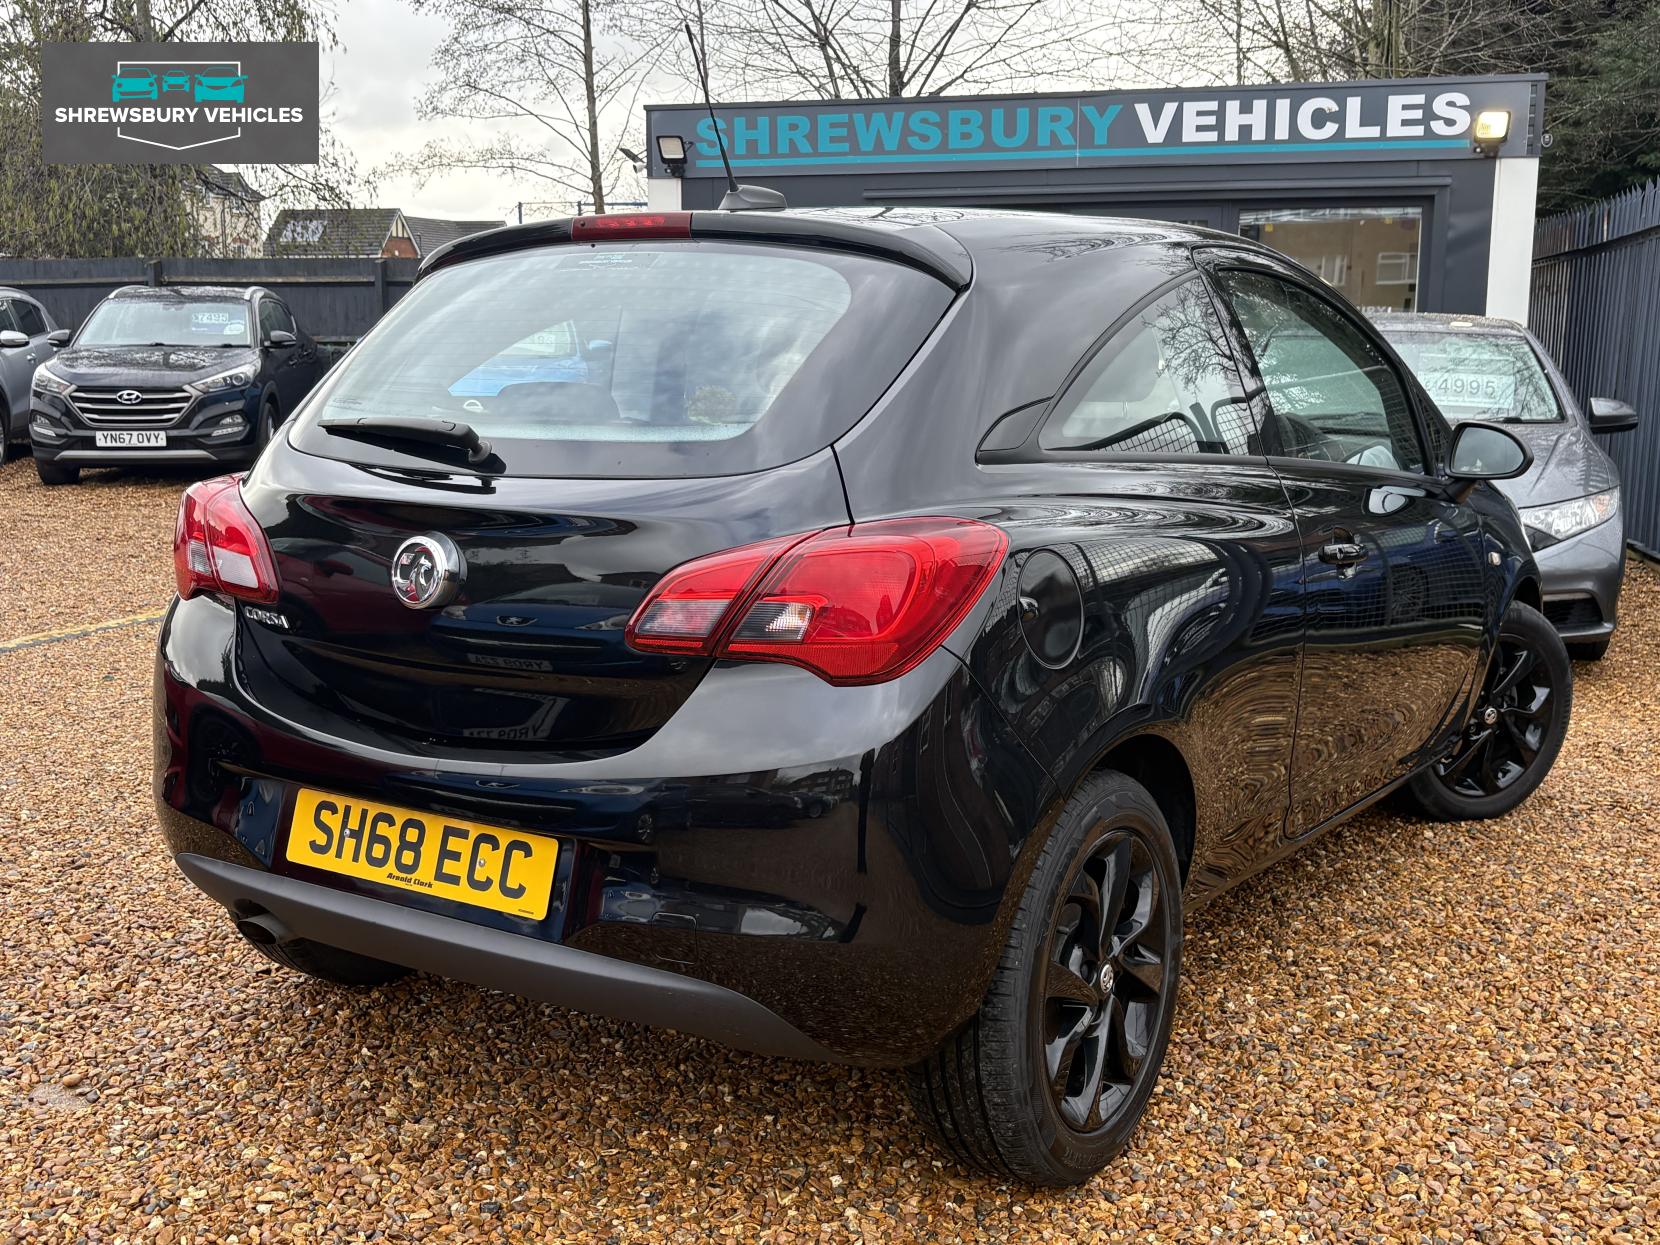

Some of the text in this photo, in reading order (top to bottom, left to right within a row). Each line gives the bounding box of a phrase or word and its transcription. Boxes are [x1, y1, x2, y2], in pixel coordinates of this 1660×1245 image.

[695, 91, 1472, 156] SHREWSBURY VEHICLES
[102, 432, 160, 444] YN67 OVY
[244, 606, 289, 629] CORSA
[308, 800, 533, 900] SH68 ECC
[386, 872, 434, 889] Arnold Clark
